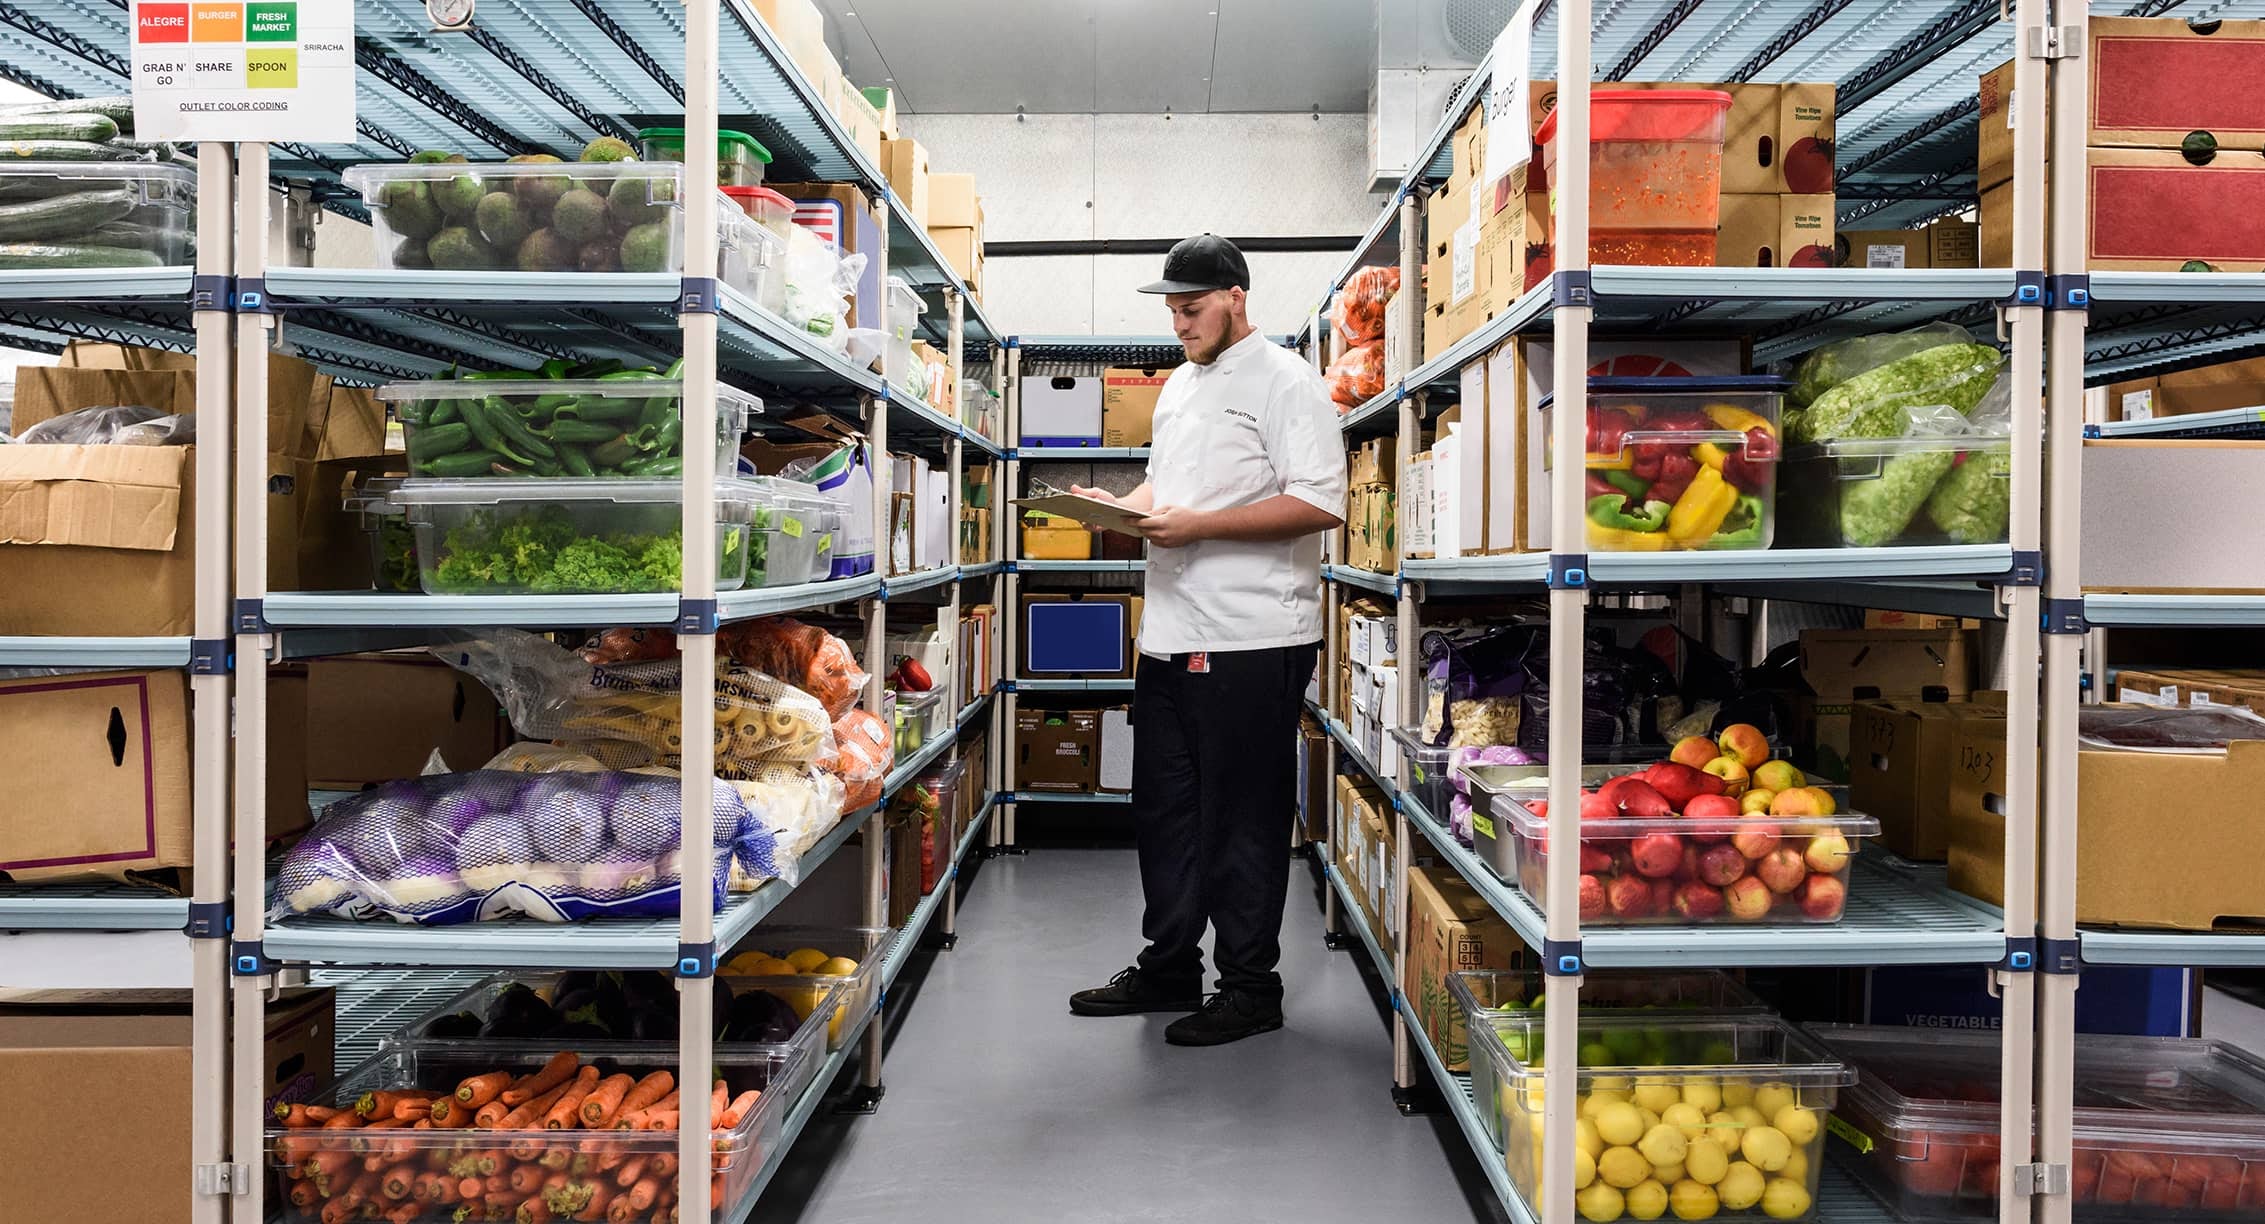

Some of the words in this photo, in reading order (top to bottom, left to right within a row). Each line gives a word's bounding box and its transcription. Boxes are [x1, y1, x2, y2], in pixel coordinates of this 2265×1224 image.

[198, 11, 238, 20] BURGER
[256, 13, 287, 21] FRESH
[140, 17, 185, 27] ALEGRE
[252, 23, 291, 32] MARKET
[142, 63, 173, 73] GRAB
[176, 63, 187, 72] N'
[195, 62, 233, 72] SHARE
[248, 62, 287, 72] SPOON
[156, 76, 173, 86] GO
[1492, 77, 1518, 121] Burger
[180, 102, 215, 111] OUTLET
[218, 102, 250, 111] COLOR
[252, 102, 288, 110] CODING
[1809, 106, 1822, 115] Ripe
[1808, 215, 1821, 223] Ripe
[1055, 748, 1080, 756] BROCCOLI
[1960, 745, 1994, 784] 1203
[1461, 943, 1468, 952] 3
[1473, 943, 1481, 952] 4
[1461, 954, 1468, 963] 5
